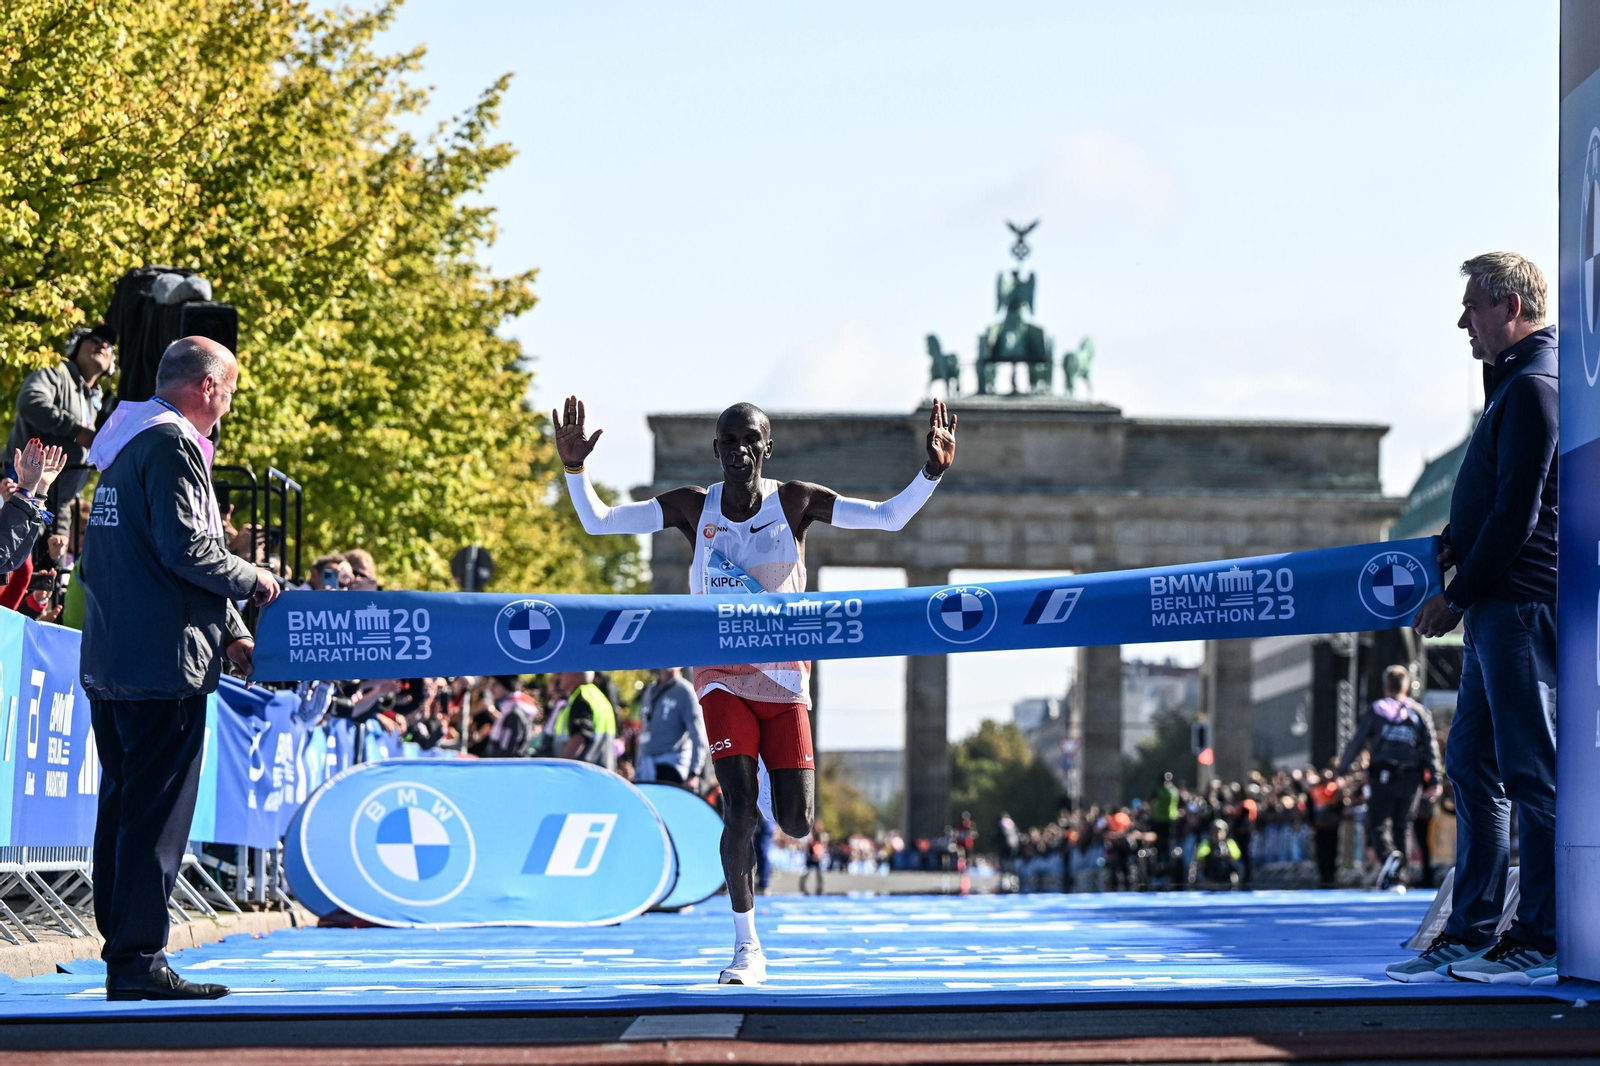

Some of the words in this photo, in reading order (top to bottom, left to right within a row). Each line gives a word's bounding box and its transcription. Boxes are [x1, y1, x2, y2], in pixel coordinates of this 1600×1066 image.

[105, 487, 118, 506] 20
[104, 507, 119, 527] 23
[1367, 555, 1419, 576] BMW
[1150, 573, 1213, 596] BMW
[1256, 568, 1294, 593] 20
[936, 587, 987, 602] BMW
[1151, 595, 1216, 611] BERLIN
[503, 601, 555, 618] BMW
[718, 603, 782, 618] BMW
[824, 598, 863, 618] 20
[1152, 609, 1255, 627] MARATHON
[1257, 596, 1295, 620] 23
[288, 610, 351, 631] BMW
[393, 608, 430, 633] 20
[718, 618, 784, 633] BERLIN
[289, 631, 353, 646] BERLIN
[719, 632, 823, 649] MARATHON
[826, 620, 864, 644] 23
[290, 646, 392, 663] MARATHON
[395, 635, 432, 660] 23
[364, 788, 454, 824] BMW
